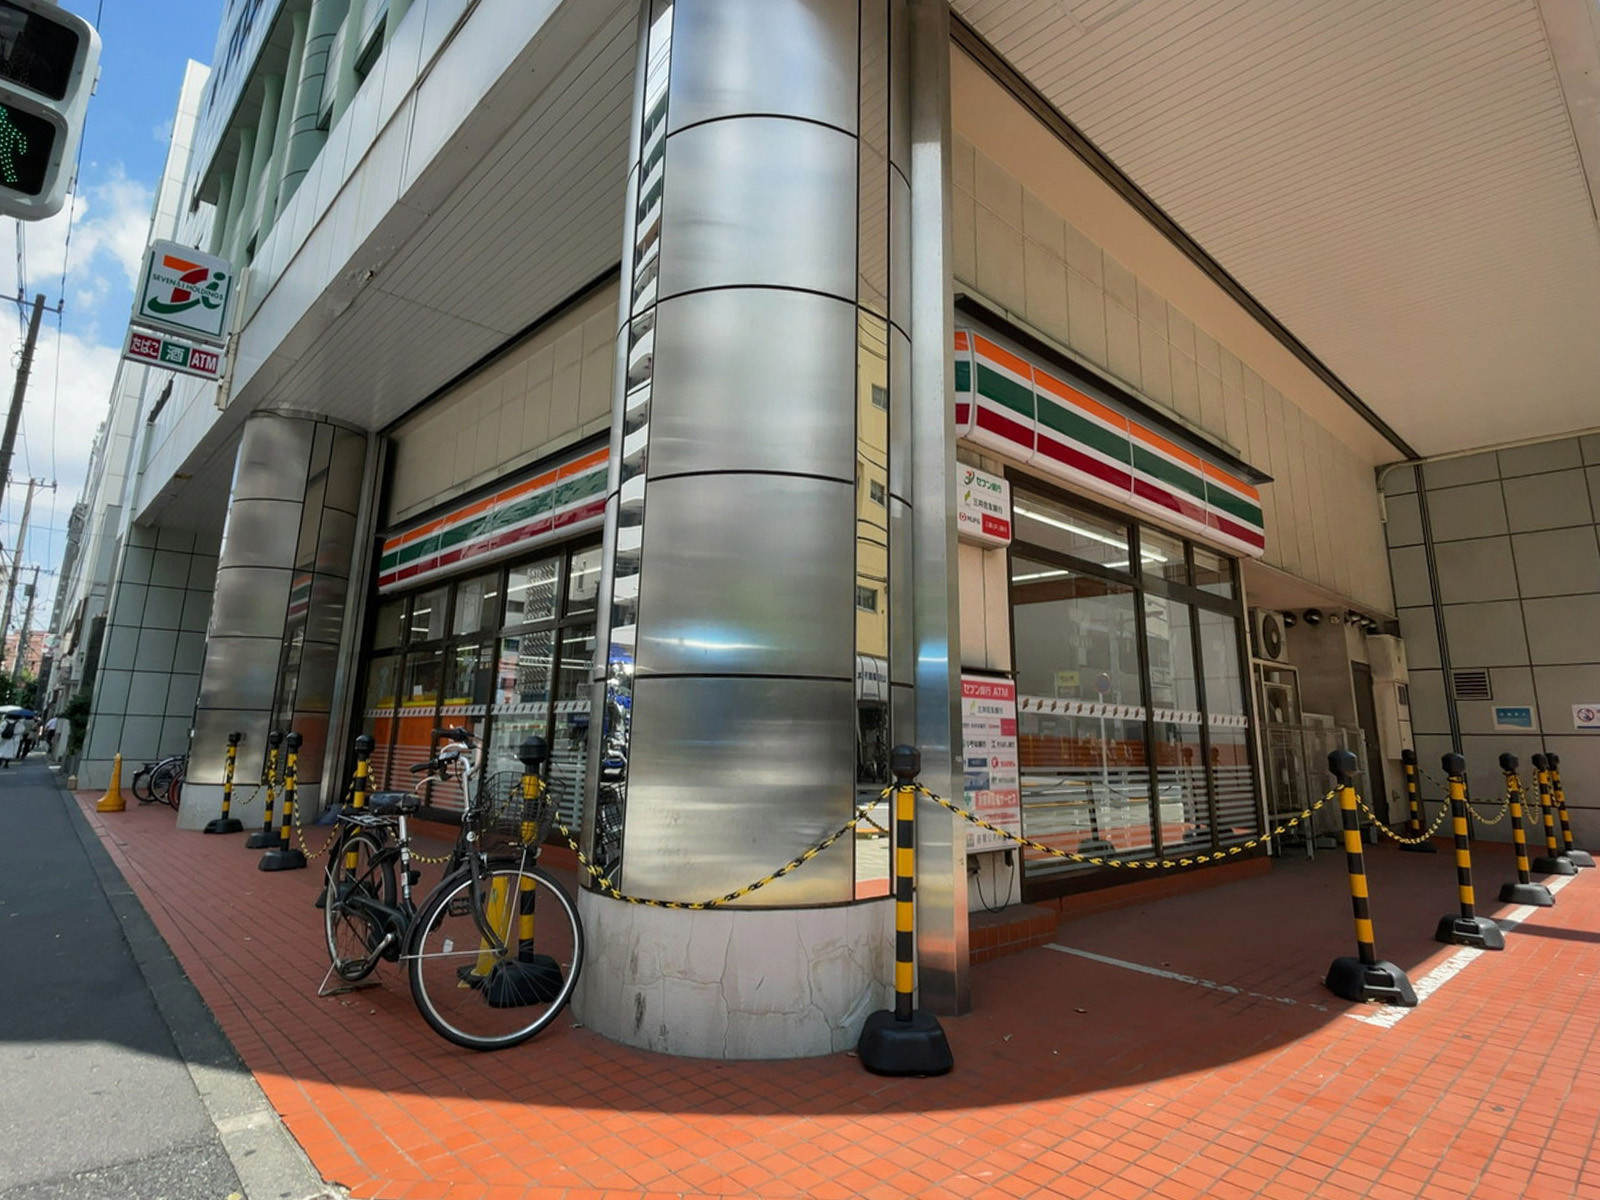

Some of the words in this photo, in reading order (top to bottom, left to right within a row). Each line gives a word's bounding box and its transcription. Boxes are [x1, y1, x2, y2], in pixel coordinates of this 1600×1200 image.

[152, 273, 176, 286] SEVEN
[186, 284, 224, 301] HOLDINGS
[130, 337, 159, 356] たばこ
[165, 344, 186, 363] 酒
[191, 352, 218, 371] ATM
[976, 476, 1002, 494] セブン銀行
[993, 686, 1008, 698] ATM
